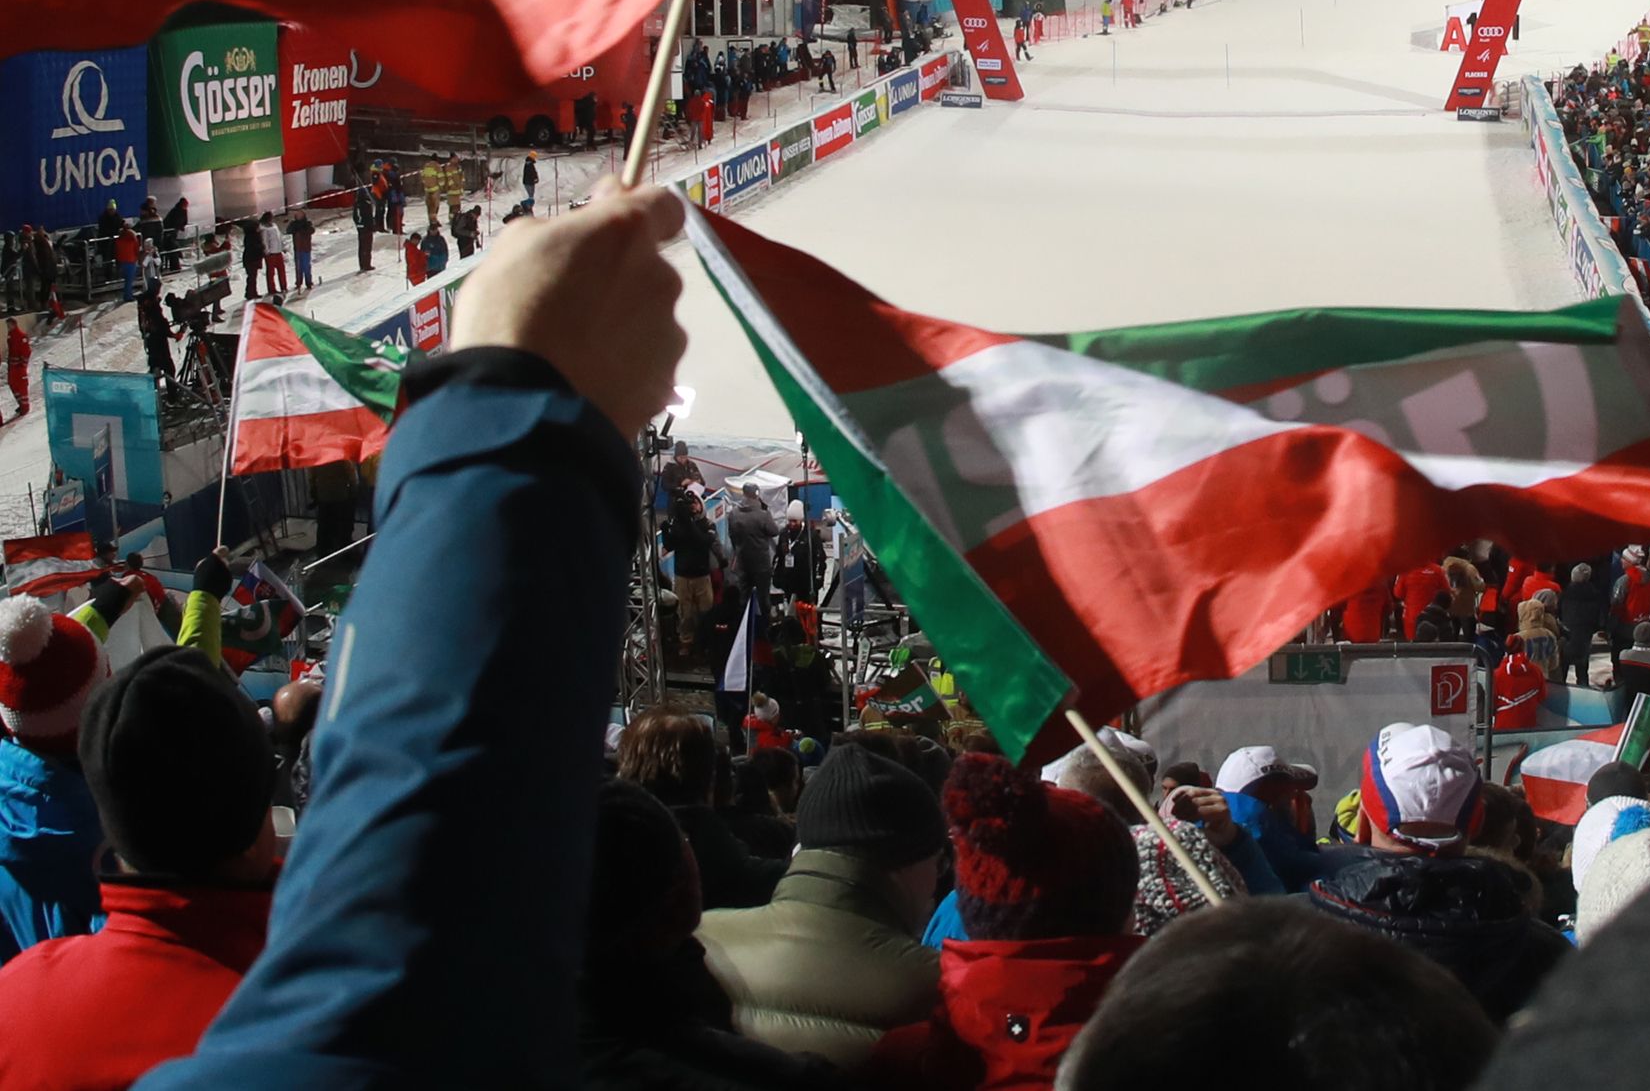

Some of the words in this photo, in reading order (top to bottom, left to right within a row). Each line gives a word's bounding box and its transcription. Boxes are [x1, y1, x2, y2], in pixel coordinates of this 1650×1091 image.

[292, 64, 348, 95] Kronen
[181, 51, 276, 141] Gösser
[942, 95, 981, 103] LONGINES
[291, 97, 347, 129] Zeitung
[1459, 109, 1498, 117] LONGINES
[40, 146, 141, 195] UNIQA
[737, 153, 767, 185] UNIQA
